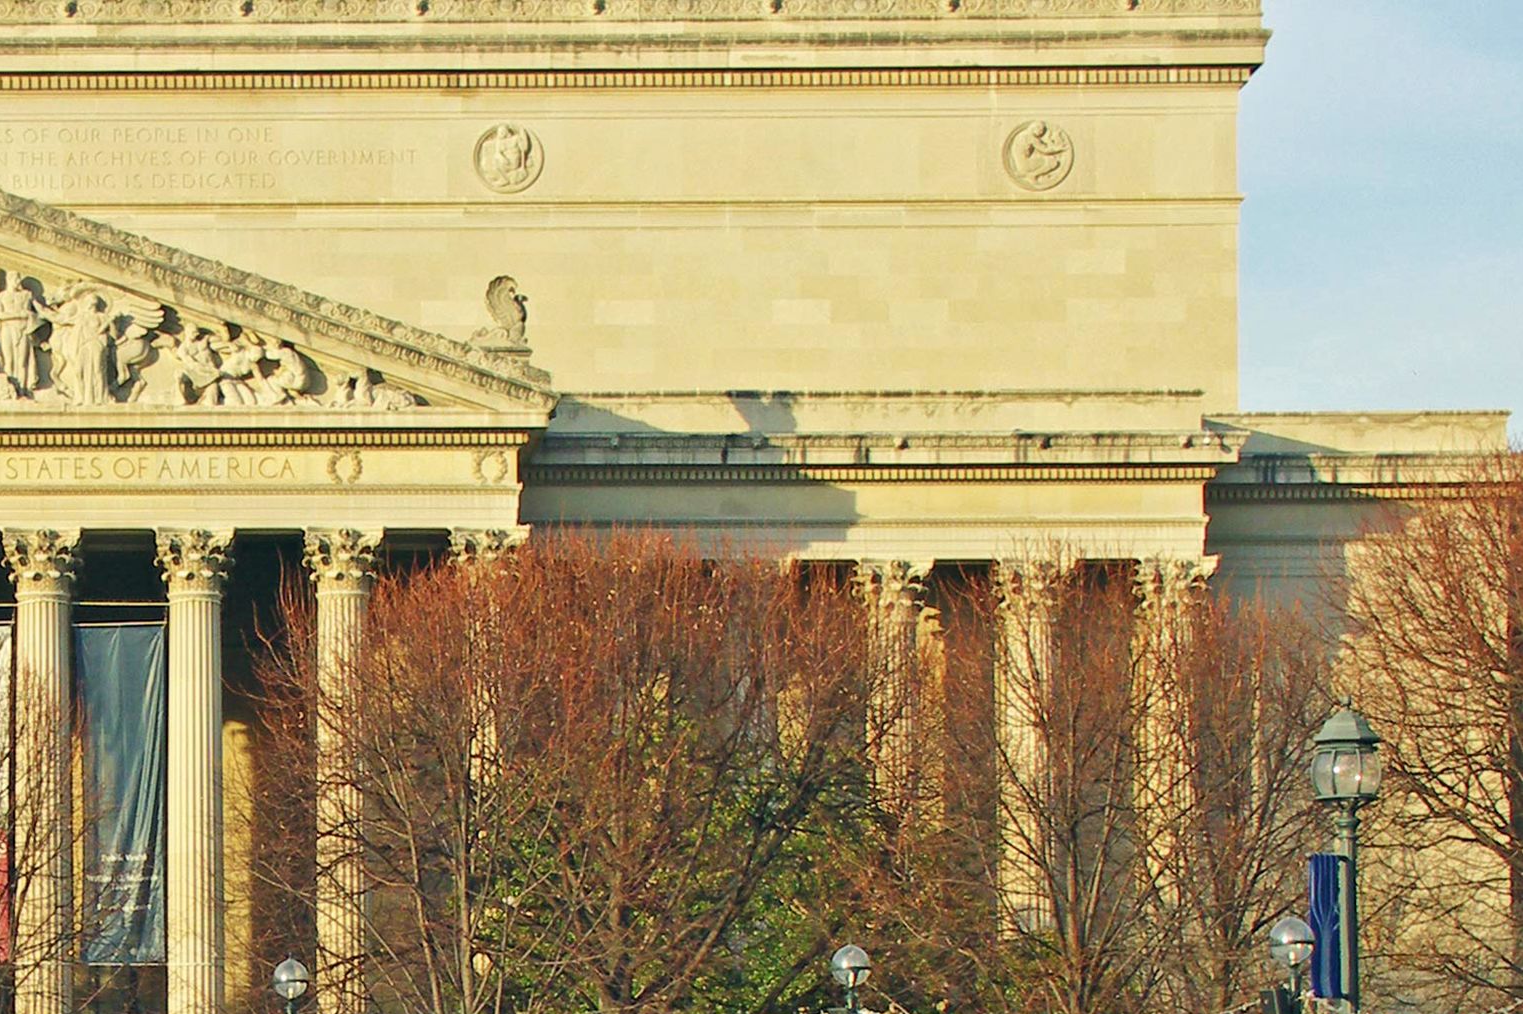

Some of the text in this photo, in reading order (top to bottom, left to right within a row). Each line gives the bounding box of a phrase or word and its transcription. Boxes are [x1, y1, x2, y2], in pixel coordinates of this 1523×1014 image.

[22, 128, 51, 144] OF
[58, 128, 101, 144] OUR
[113, 128, 187, 144] PEOPLE
[196, 127, 219, 143] IN
[227, 127, 274, 143] ONE
[17, 151, 57, 167] THE
[66, 151, 172, 167] ARCHIVES
[180, 151, 207, 166] OF
[215, 151, 259, 166] OUR
[268, 150, 417, 166] GOVERNMENT
[12, 174, 116, 190] BUILDING
[125, 173, 143, 189] IS
[151, 173, 276, 189] DEDICATED
[4, 456, 103, 480] STATES
[113, 456, 149, 479] OF
[157, 456, 297, 479] AMERICA
